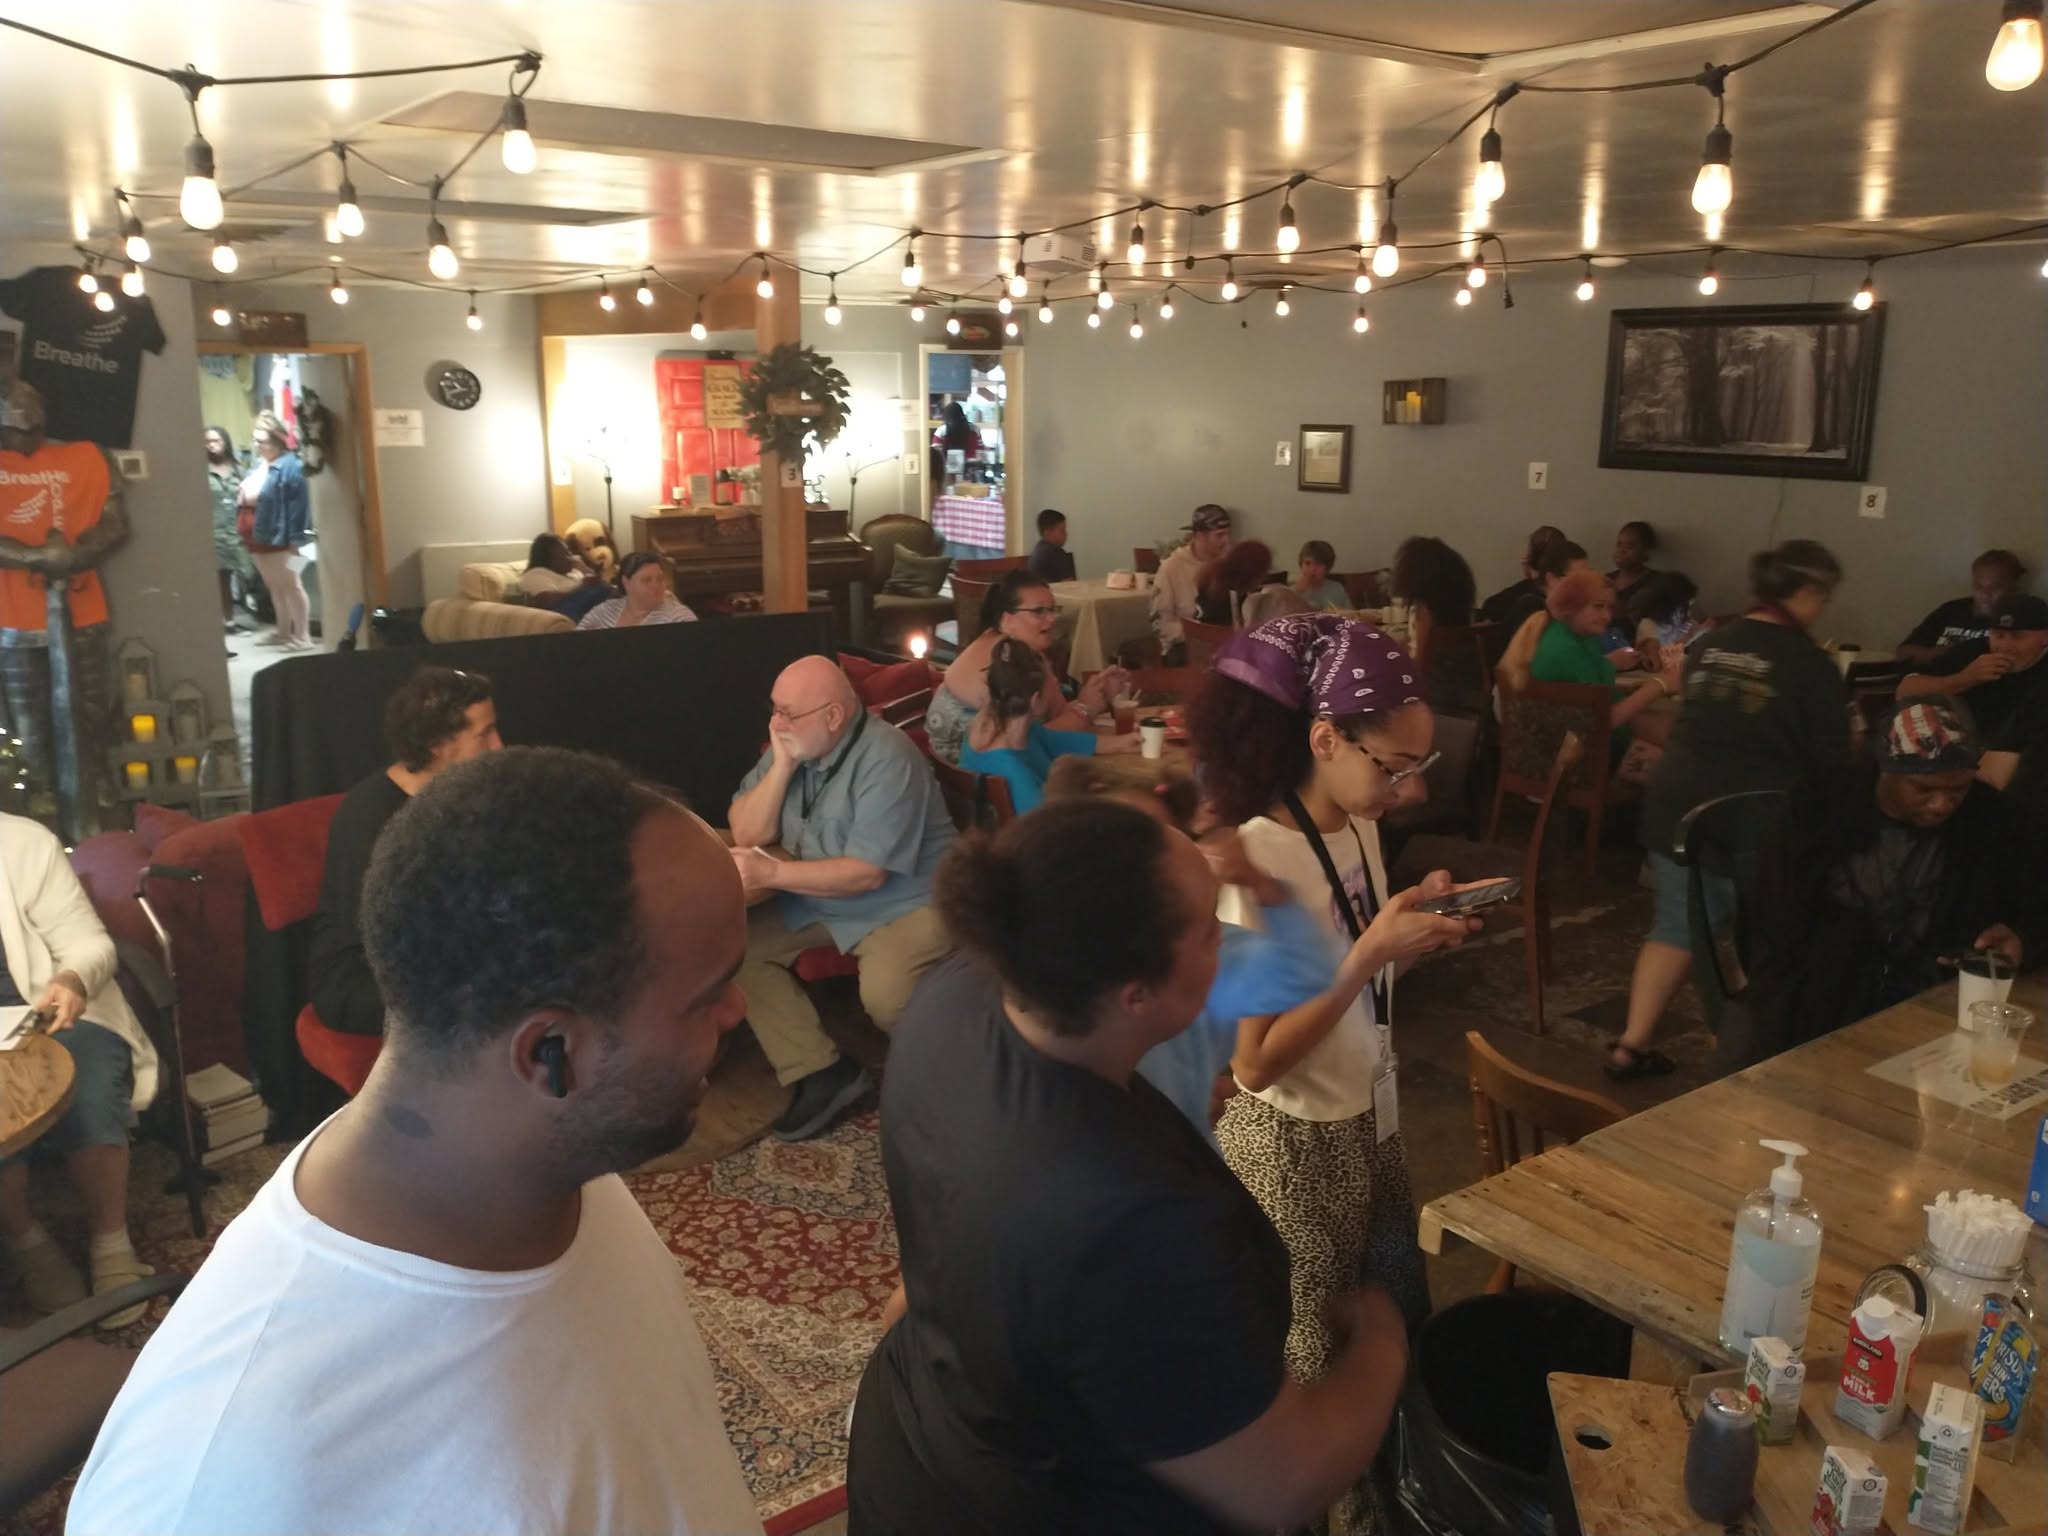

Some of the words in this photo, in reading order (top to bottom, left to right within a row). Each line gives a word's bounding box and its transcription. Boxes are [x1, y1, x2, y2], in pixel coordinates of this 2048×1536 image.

[34, 340, 119, 374] Breathe
[788, 468, 796, 480] 3
[1535, 472, 1544, 484] 7
[1865, 494, 1876, 508] 8
[1843, 1375, 1876, 1402] MILK
